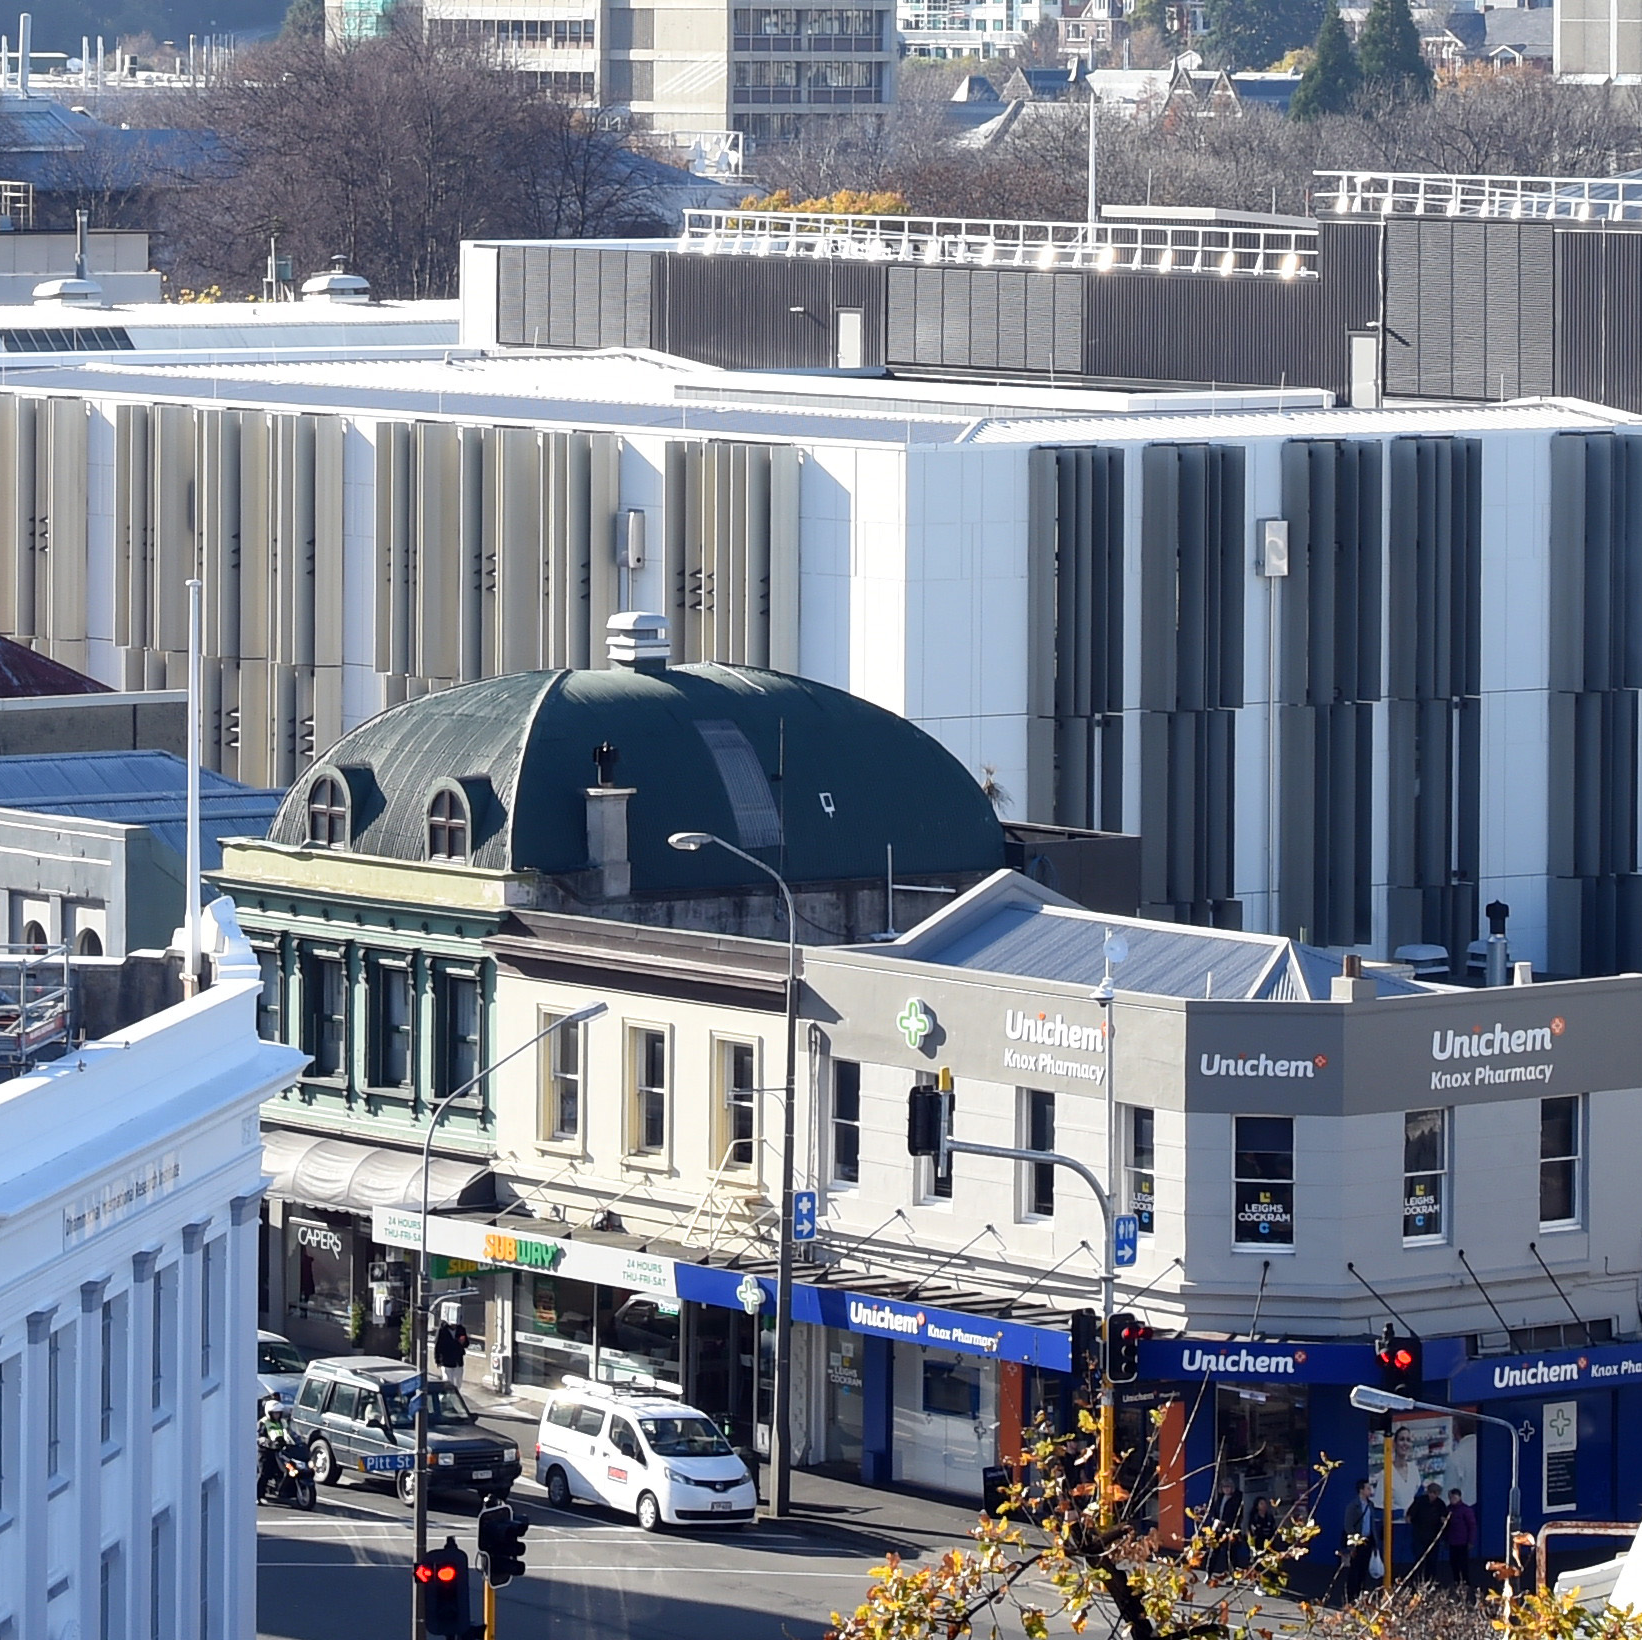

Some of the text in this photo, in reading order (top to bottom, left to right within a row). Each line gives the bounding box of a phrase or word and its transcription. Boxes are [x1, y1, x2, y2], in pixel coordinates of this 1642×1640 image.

[1005, 1008, 1105, 1053] Unichem
[1431, 1022, 1553, 1061] Unichem
[1003, 1047, 1106, 1086] Knox Pharmacy
[1200, 1052, 1314, 1078] Unichem
[1430, 1064, 1554, 1090] Knox Pharmacy
[1245, 1203, 1283, 1213] LEIGHS
[1404, 1195, 1435, 1207] LEIGHS
[1404, 1204, 1440, 1216] OCKRAM
[388, 1216, 422, 1230] 24 HOURS
[1238, 1212, 1291, 1222] COCKRAM
[298, 1226, 342, 1260] CAPERS
[383, 1227, 422, 1242] THU-FRI-SA
[483, 1234, 557, 1267] SUBWAY
[622, 1270, 667, 1287] THU-FRI-SAT
[627, 1259, 663, 1274] 24 HOURS
[849, 1301, 920, 1335] Unichem
[927, 1323, 951, 1341] Knox
[1182, 1348, 1295, 1374] Unichem
[1493, 1361, 1578, 1389] Unichem
[1591, 1364, 1618, 1378] Knox
[366, 1454, 410, 1470] Pitt St
